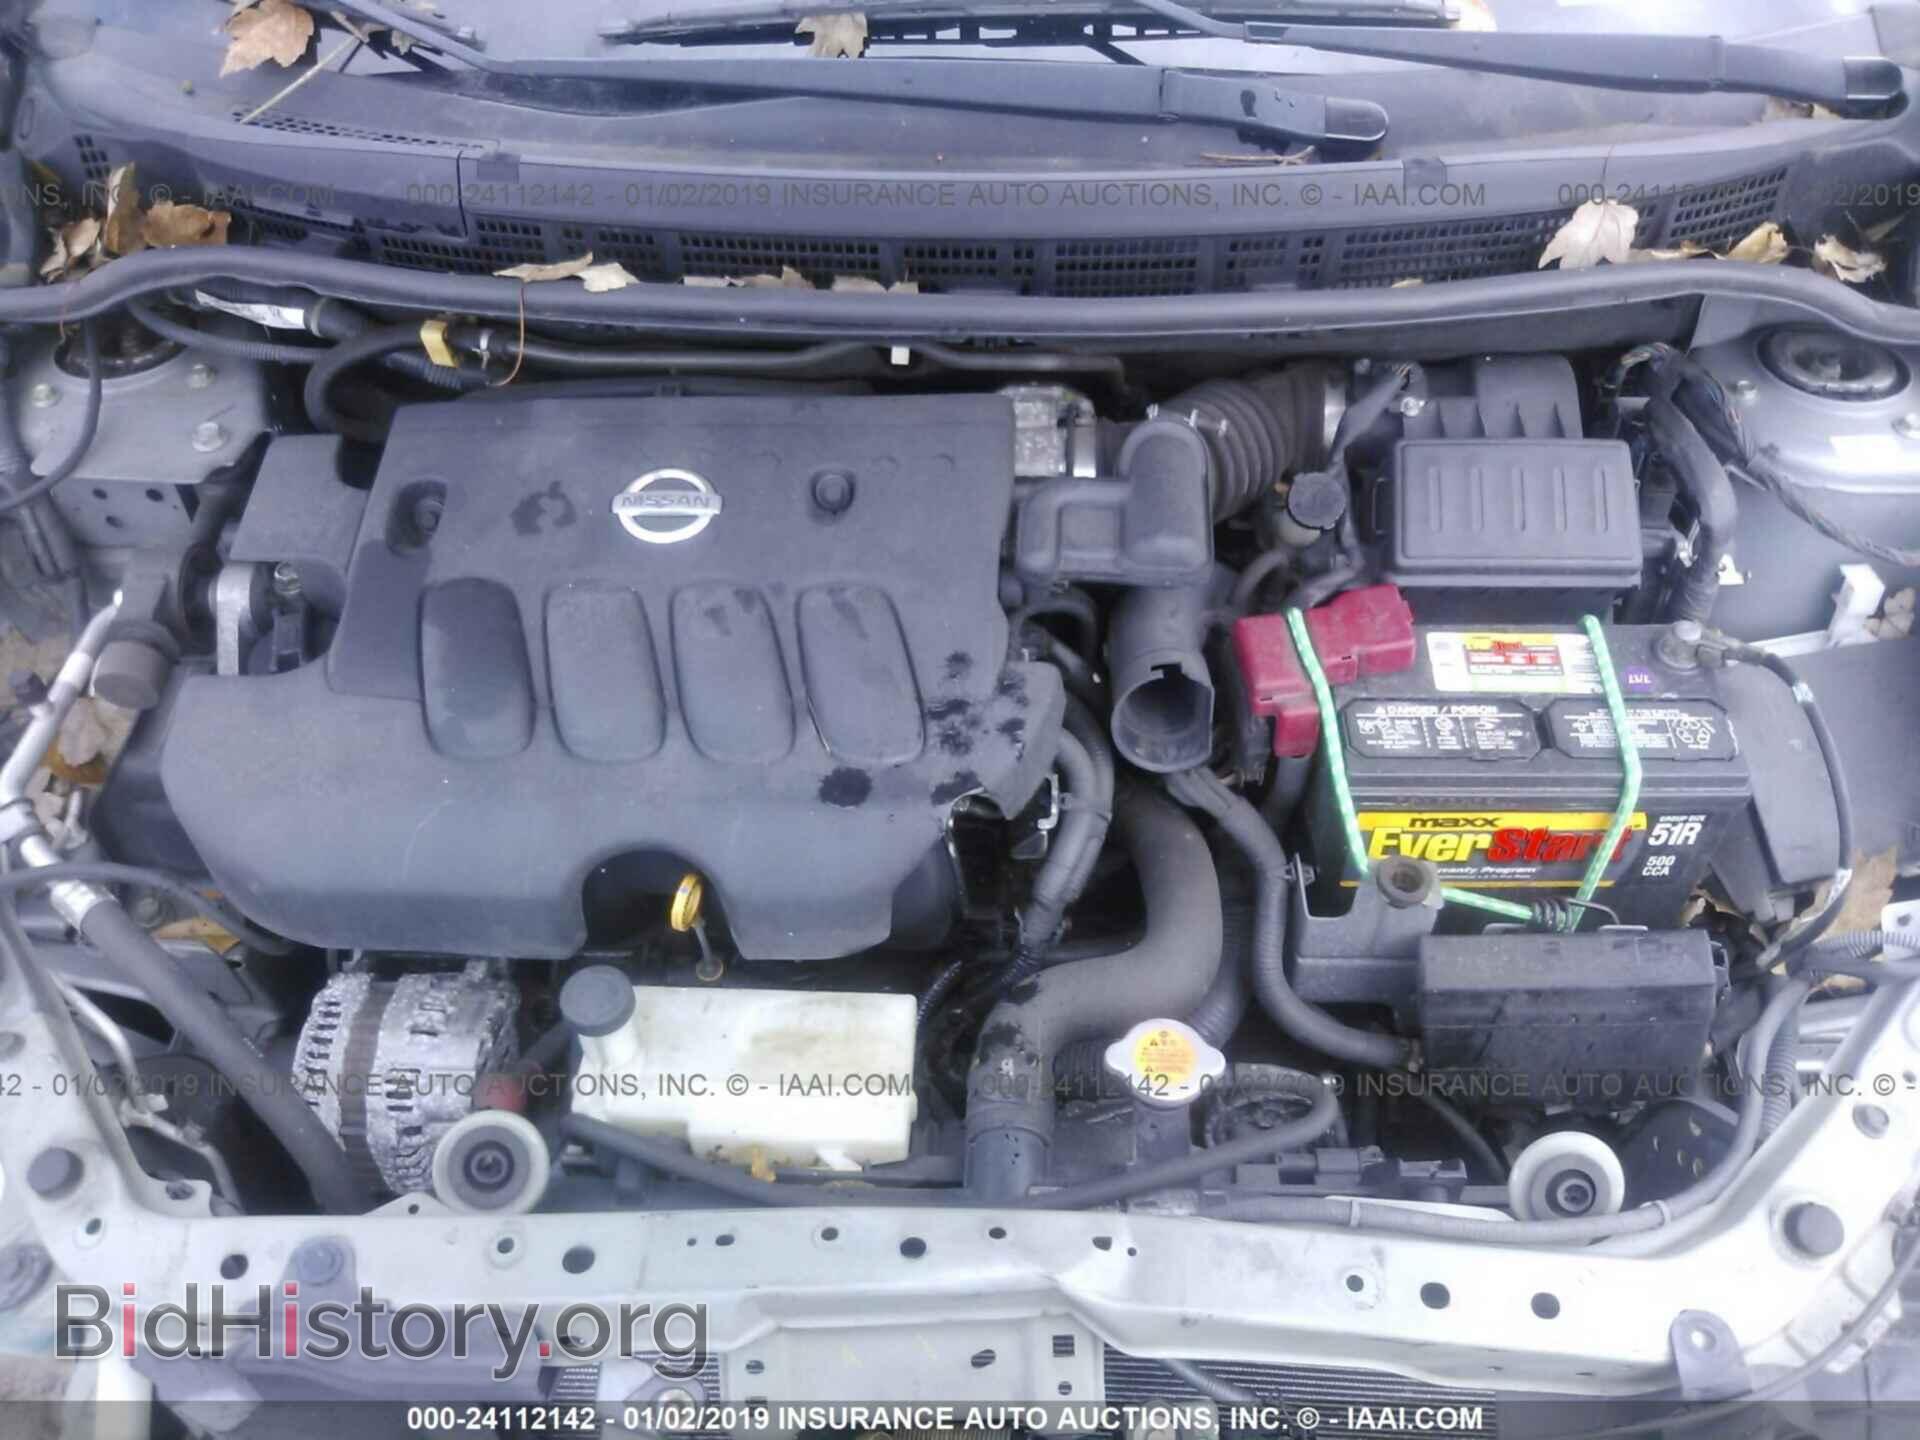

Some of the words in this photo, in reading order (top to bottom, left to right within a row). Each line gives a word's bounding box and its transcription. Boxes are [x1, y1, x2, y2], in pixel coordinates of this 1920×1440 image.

[621, 494, 710, 508] NISSAN
[1408, 817, 1501, 828] maxx
[1648, 823, 1702, 846] 51R
[1646, 855, 1676, 866] 500
[1642, 866, 1671, 876] CCA
